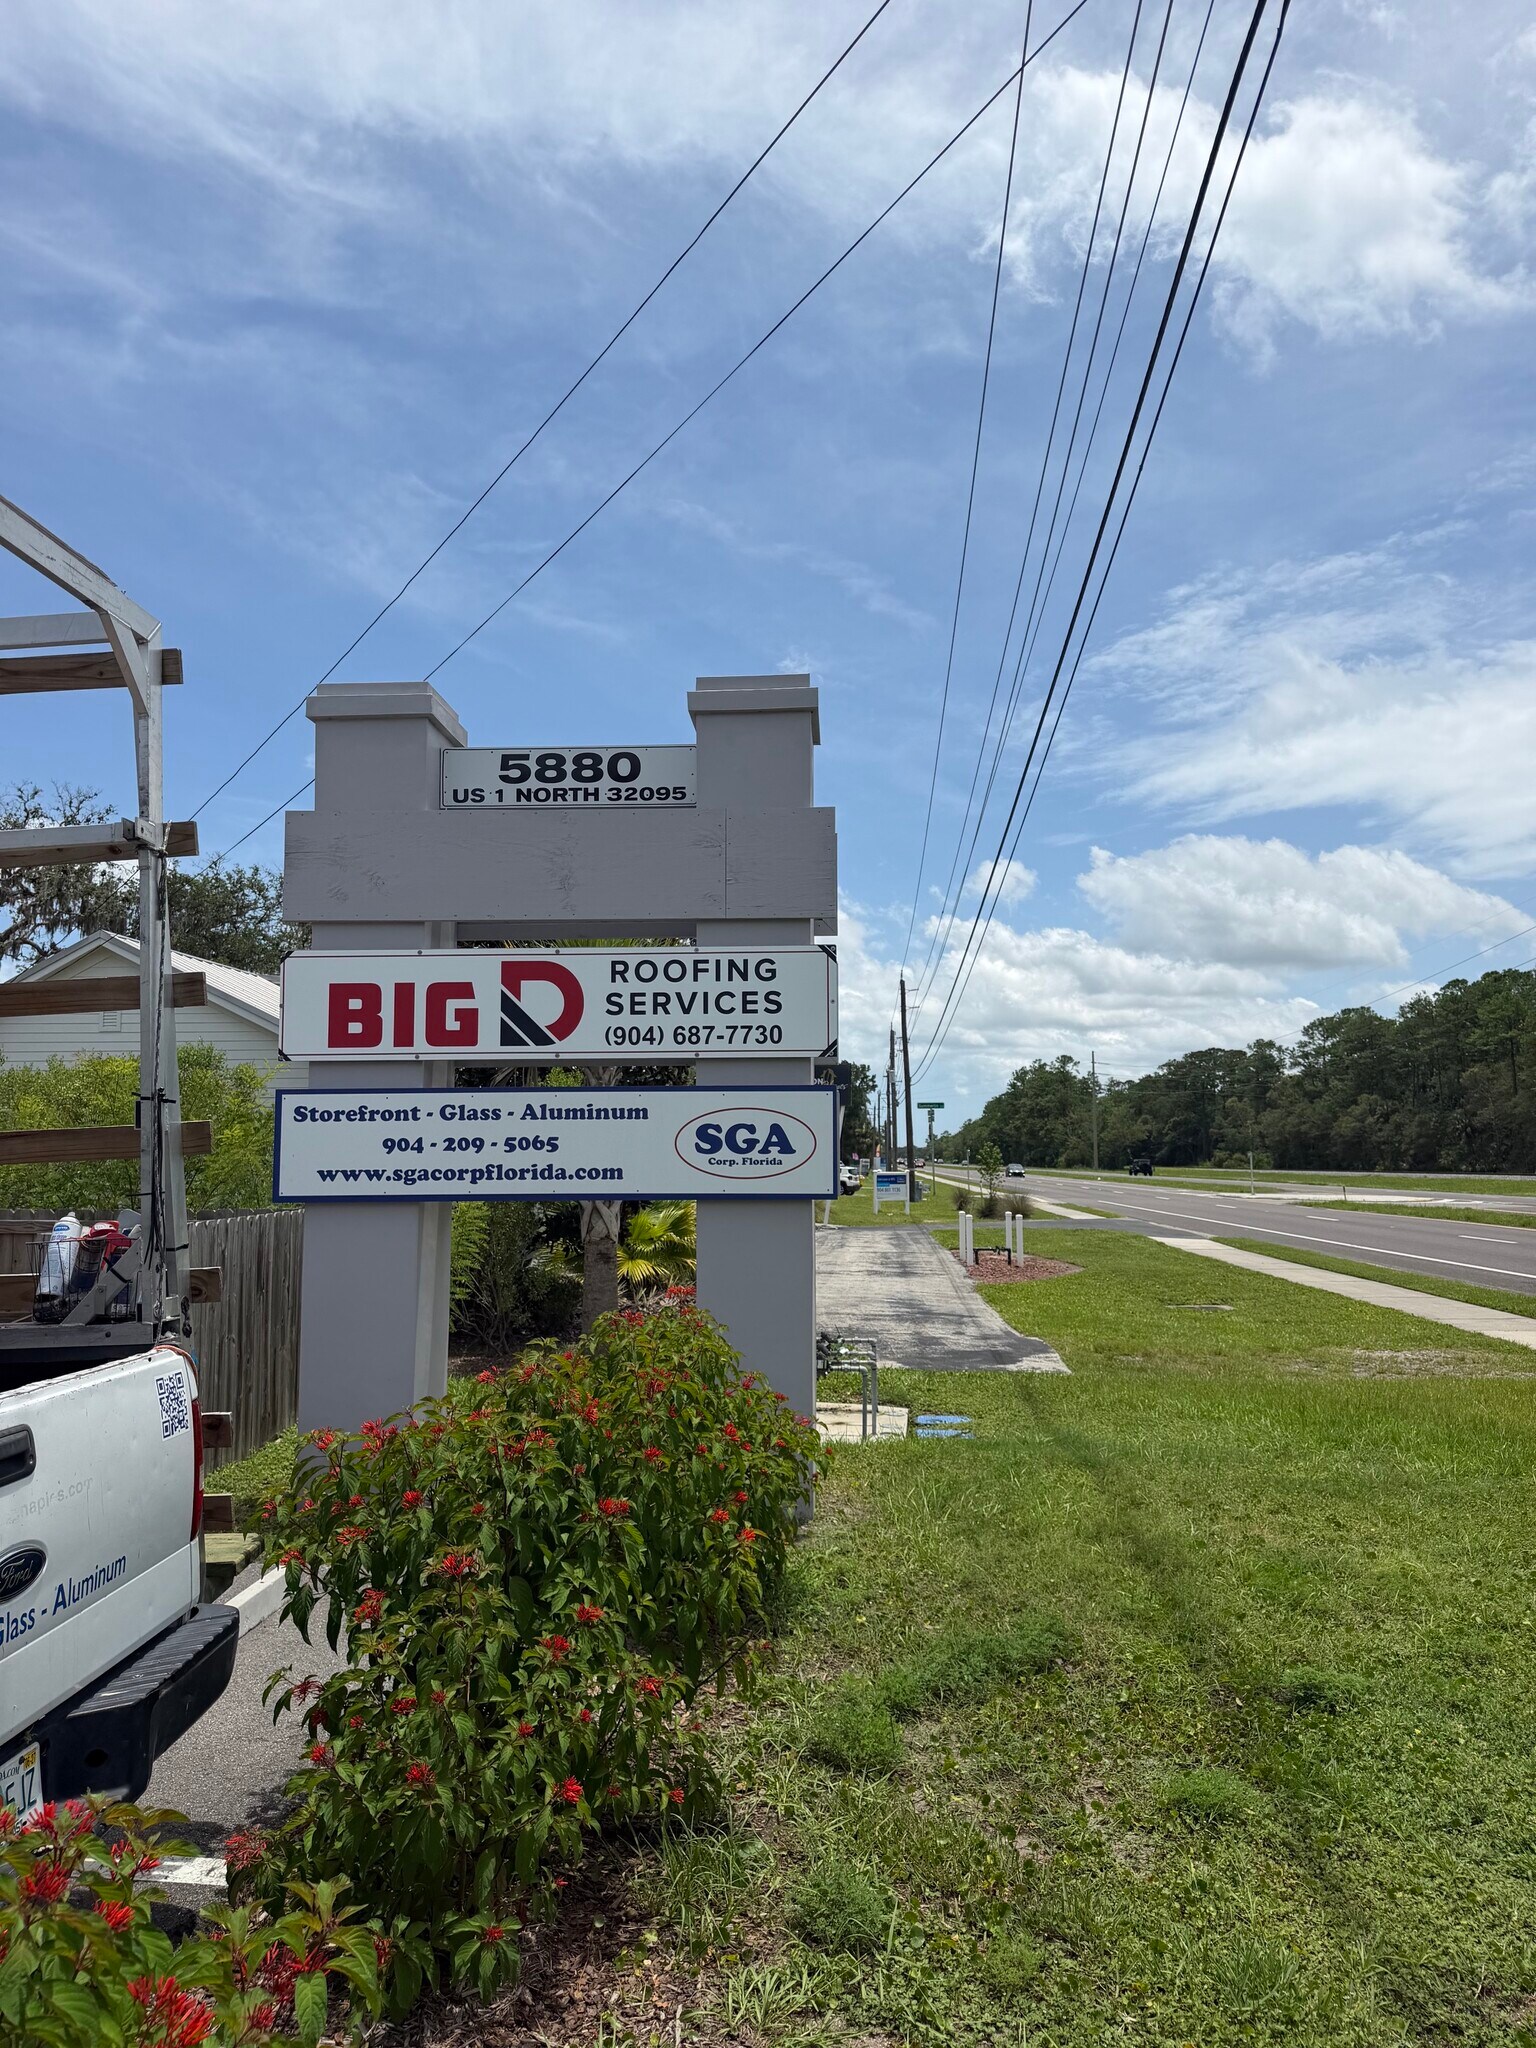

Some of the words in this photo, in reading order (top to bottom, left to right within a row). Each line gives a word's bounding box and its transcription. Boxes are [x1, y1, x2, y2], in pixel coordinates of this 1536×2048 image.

[498, 752, 641, 784] 5880
[452, 787, 483, 803] US
[495, 788, 504, 803] 1
[515, 787, 600, 803] NORTH
[608, 785, 687, 803] 32095
[610, 957, 776, 983] ROOFING
[328, 982, 478, 1048] BIG
[500, 961, 584, 1047] D
[605, 990, 782, 1016] SERVICES
[605, 1025, 664, 1046] (904)
[673, 1025, 783, 1046] 687-7730
[293, 1105, 421, 1123] Storefront
[438, 1103, 501, 1122] Glass
[519, 1102, 648, 1121] Aluminum
[382, 1137, 424, 1154] 904
[443, 1137, 486, 1155] 209
[504, 1135, 559, 1154] 5065
[694, 1122, 796, 1155] SGA
[317, 1163, 623, 1186] www.sgacorpflorida.com
[708, 1156, 739, 1168] Corp.
[742, 1156, 782, 1166] Florida
[0, 1559, 33, 1591] Ford
[52, 1555, 126, 1616] Aluminum
